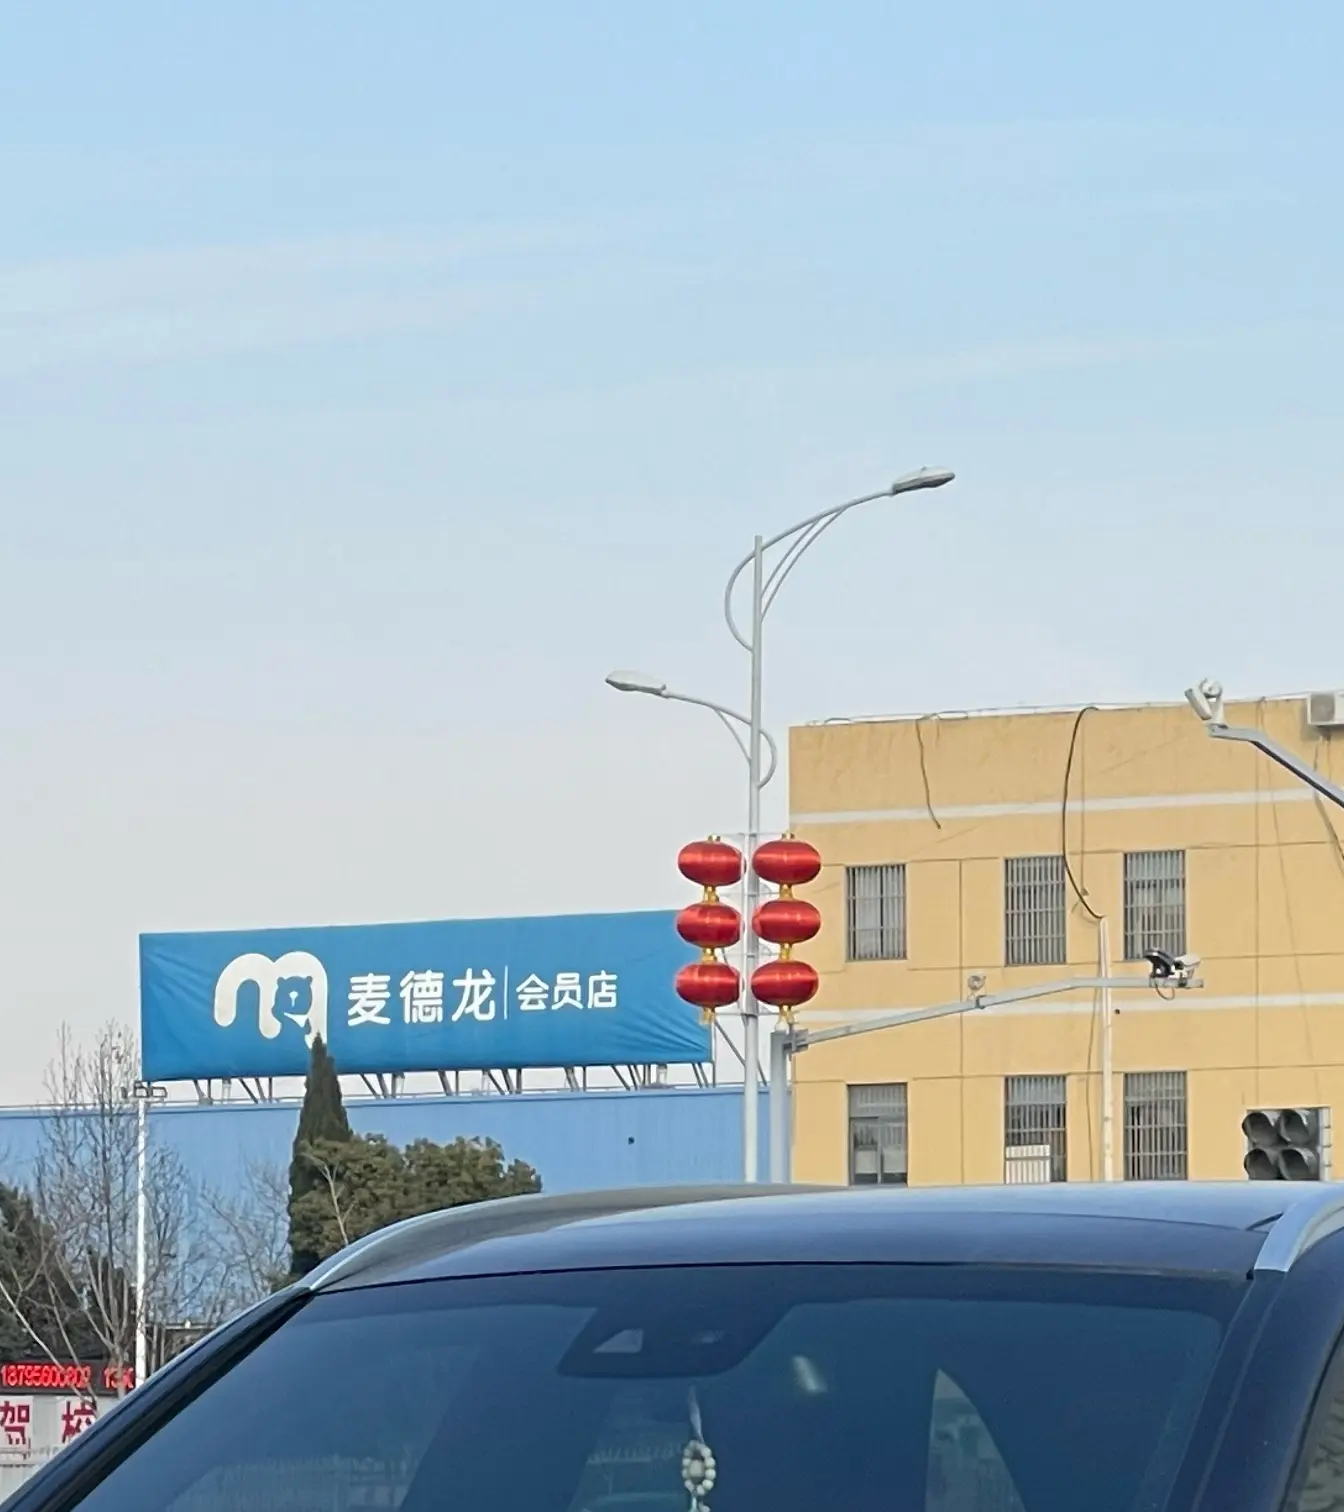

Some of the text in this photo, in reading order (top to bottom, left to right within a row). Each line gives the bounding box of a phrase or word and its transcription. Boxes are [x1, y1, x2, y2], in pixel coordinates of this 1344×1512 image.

[347, 967, 618, 1025] 麦德龙 会员店
